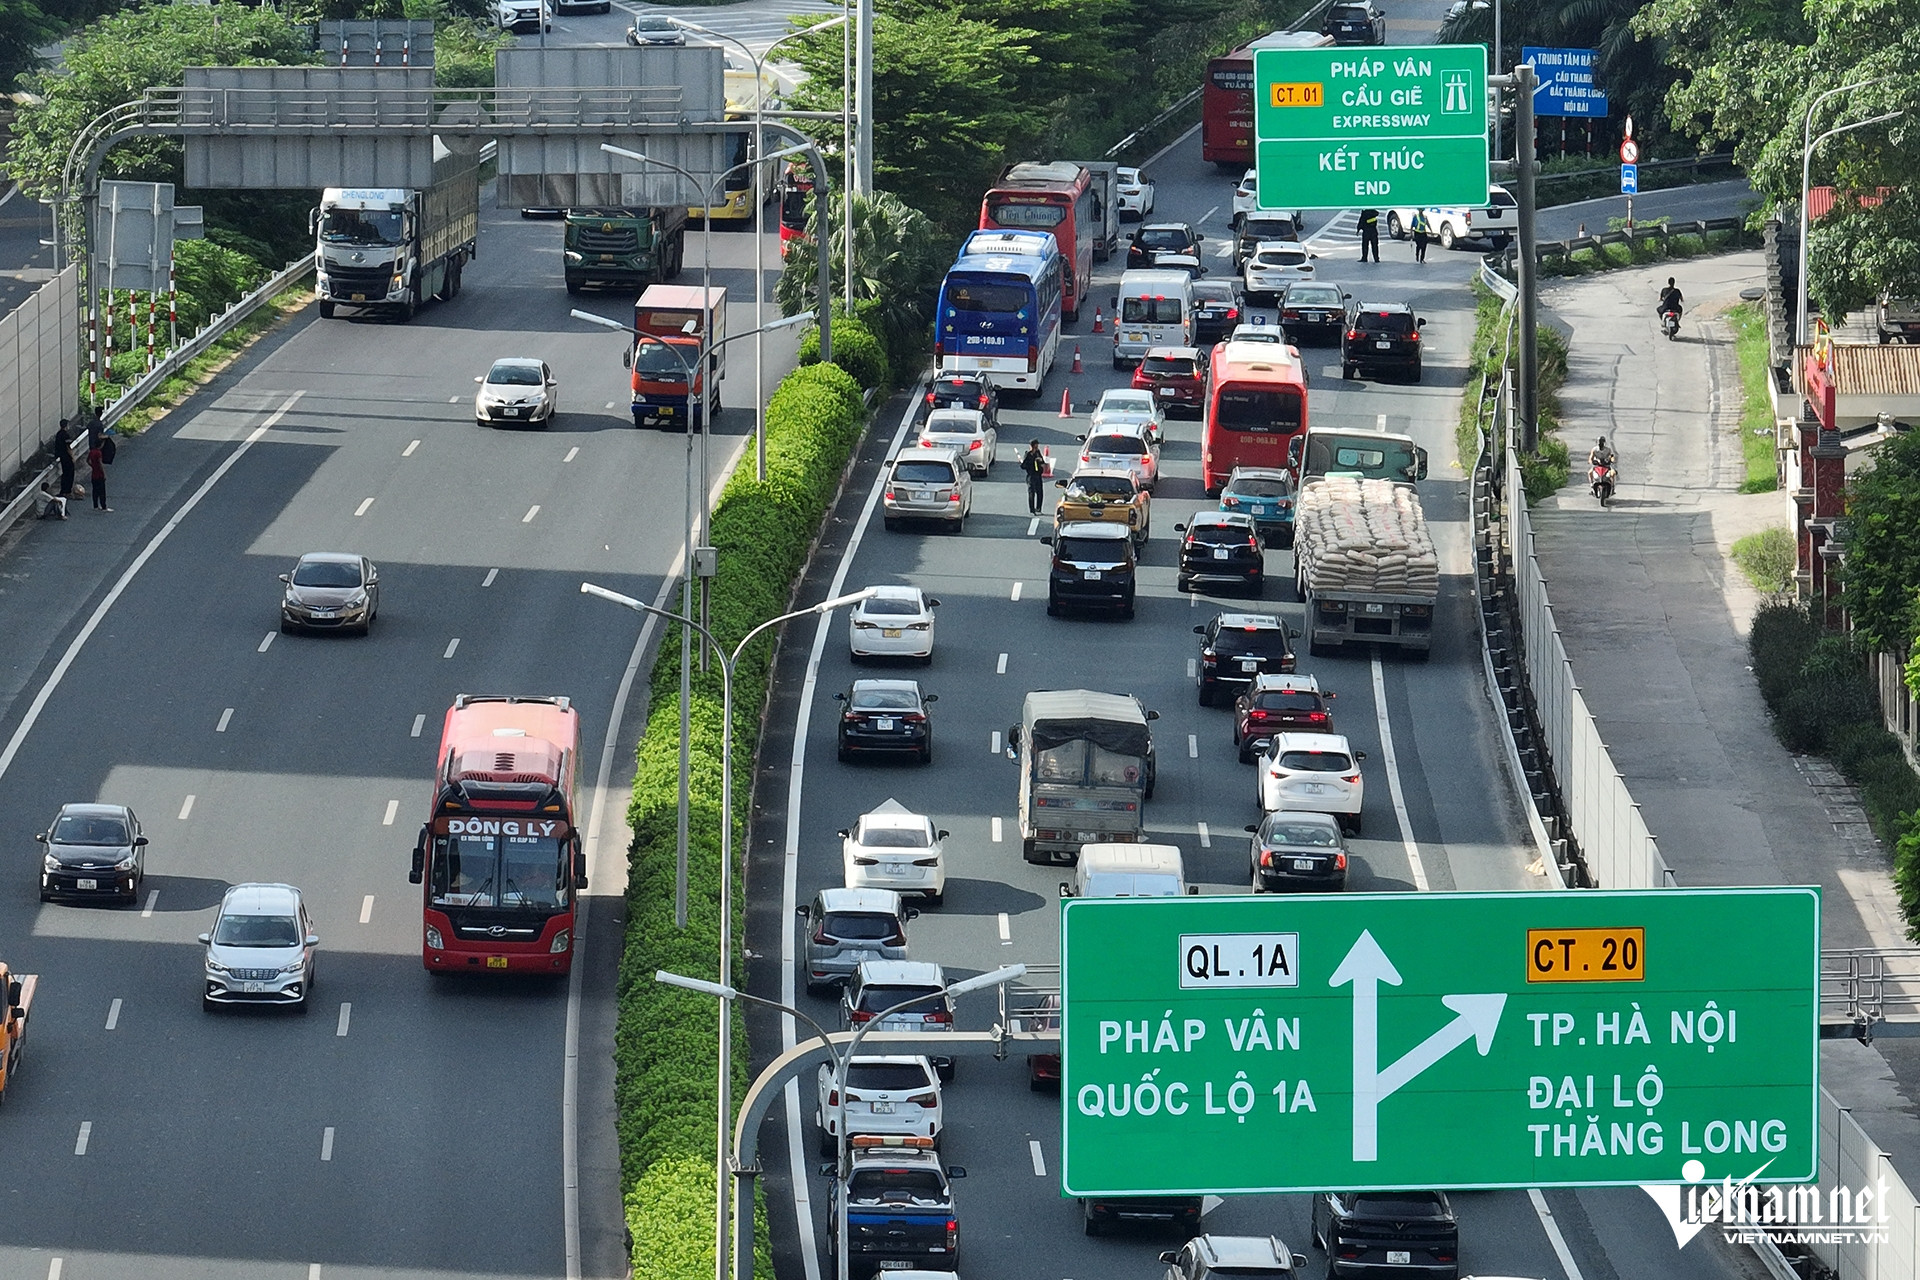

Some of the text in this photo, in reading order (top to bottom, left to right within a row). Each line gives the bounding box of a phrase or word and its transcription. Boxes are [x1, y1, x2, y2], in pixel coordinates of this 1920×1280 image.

[1330, 56, 1432, 78] PHÁP VÂN
[1538, 53, 1562, 65] TRUNG
[1564, 52, 1580, 66] TÂM
[1342, 83, 1423, 107] CẦU GIẼ
[1550, 84, 1563, 97] BẮC
[1564, 86, 1587, 98] THĂNG
[1564, 100, 1589, 114] NỘI BÀI
[1332, 114, 1431, 128] EXPRESSWAY
[1319, 144, 1425, 171] KẾT THÚC
[1354, 180, 1391, 196] END
[448, 816, 556, 837] ĐÔNG LÝ
[1186, 943, 1290, 980] QL.1A
[1534, 937, 1638, 973] CT.20
[1100, 1008, 1300, 1054] PHÁP VÂN
[1670, 1000, 1736, 1053] NỘI
[1077, 1068, 1317, 1124] QUỐC LỘ 1A
[1526, 1064, 1664, 1117] ĐẠI LỘ
[1527, 1114, 1787, 1157] THĂNG LONG
